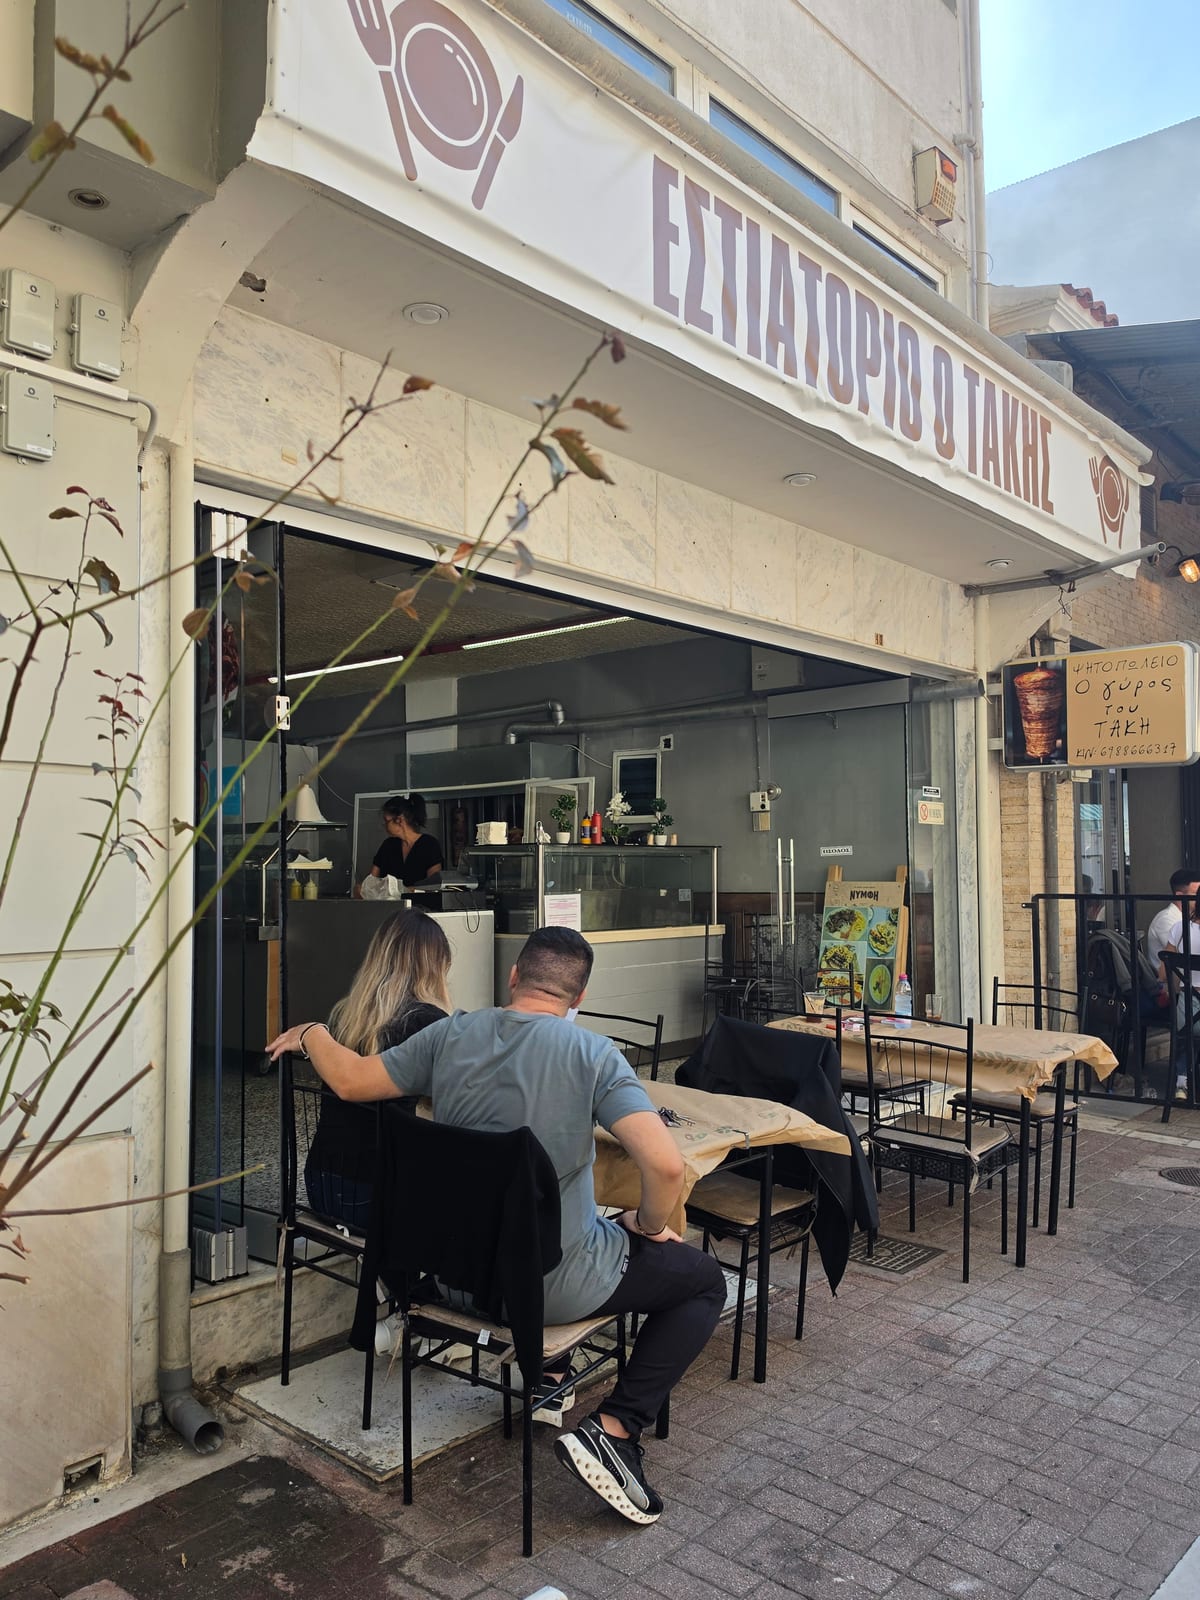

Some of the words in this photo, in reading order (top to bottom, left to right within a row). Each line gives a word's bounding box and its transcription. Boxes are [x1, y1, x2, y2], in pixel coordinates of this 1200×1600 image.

[652, 153, 922, 443] ΕΣΤΙΑΤΟΡΙΟ
[933, 345, 956, 461] Ο
[963, 363, 1055, 516] ΤΑΚΗΣ
[1073, 655, 1178, 674] ΨΗΤΟΠΩΛΕΙΟ
[1075, 679, 1090, 694] Ο
[1103, 677, 1172, 701] γύρος
[1105, 704, 1139, 716] του
